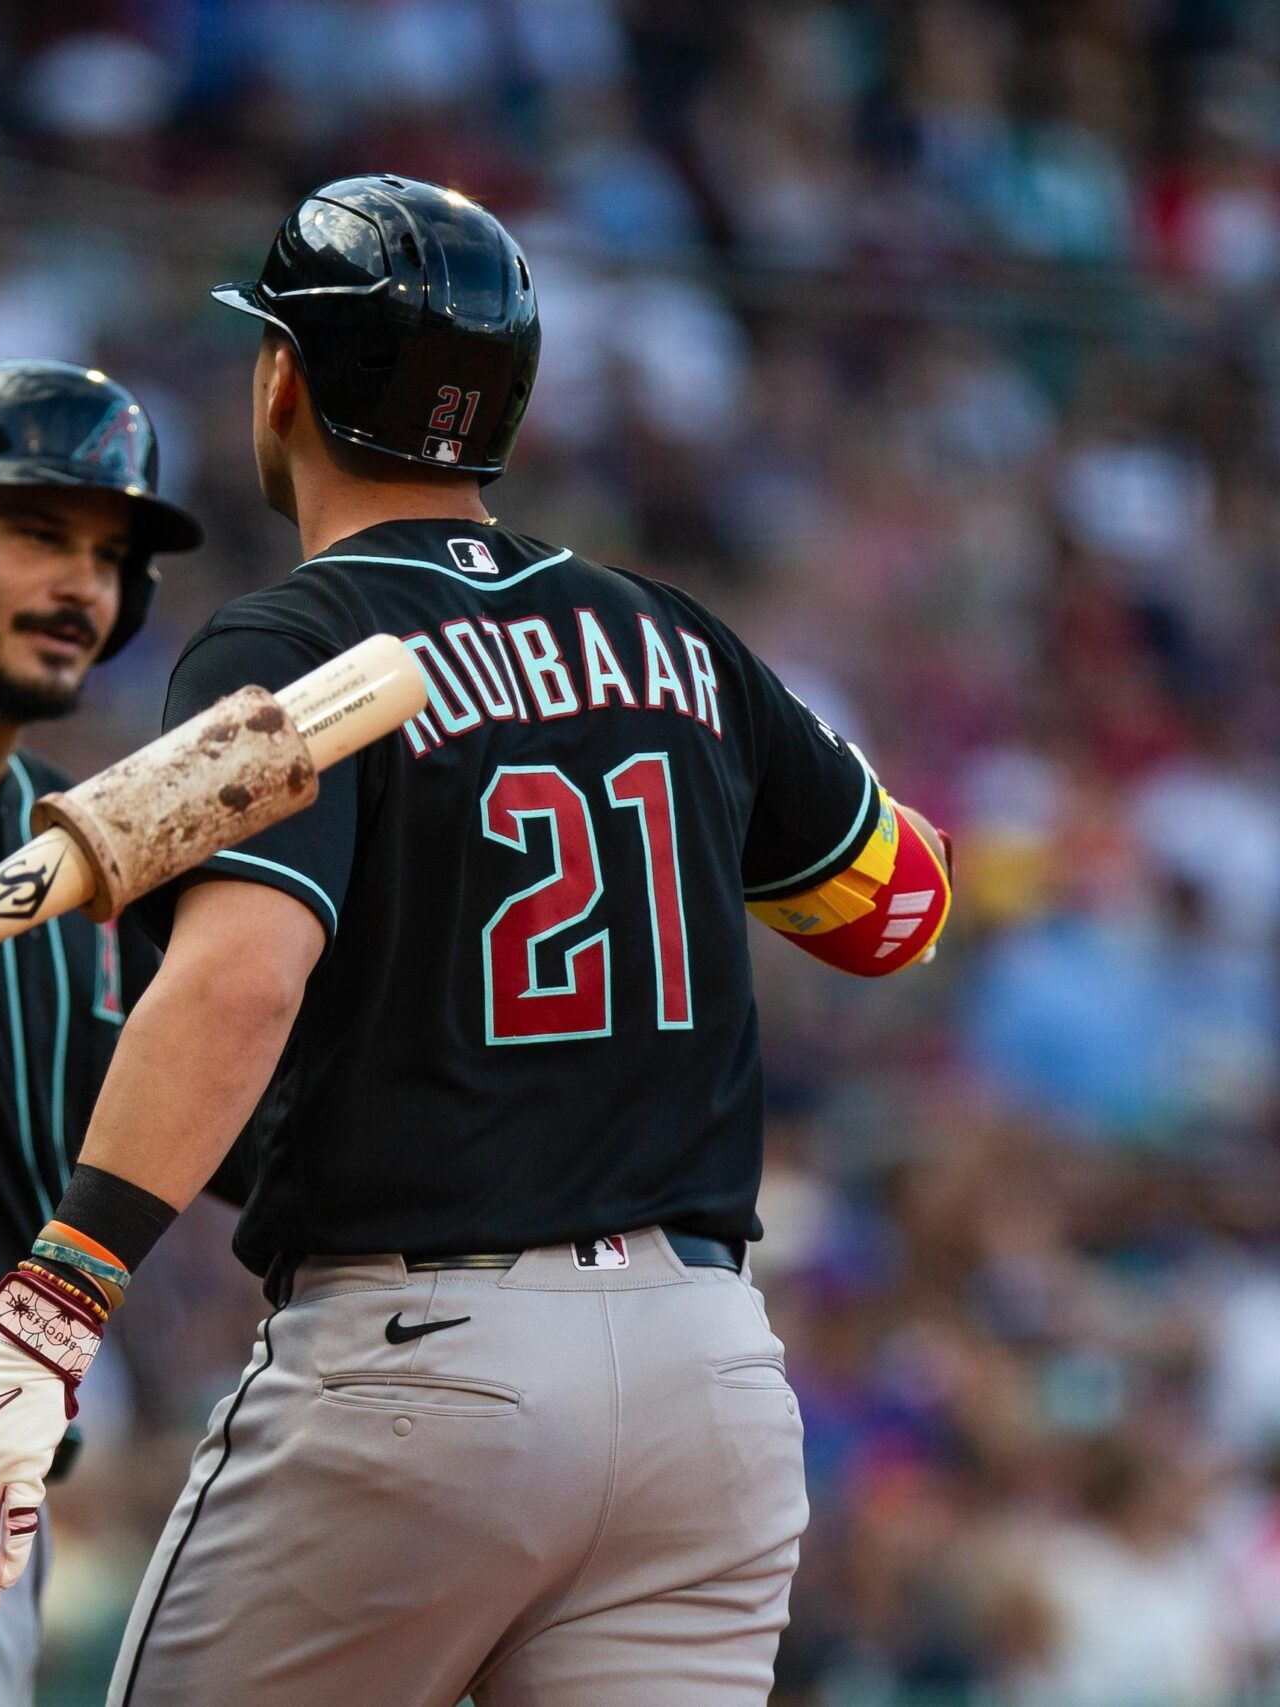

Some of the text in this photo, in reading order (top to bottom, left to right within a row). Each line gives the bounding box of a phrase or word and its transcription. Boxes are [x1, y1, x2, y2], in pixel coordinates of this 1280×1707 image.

[429, 384, 481, 435] 21
[343, 690, 376, 715] MAPLE
[480, 752, 694, 1047] 21
[39, 1320, 77, 1351] BRUCE
